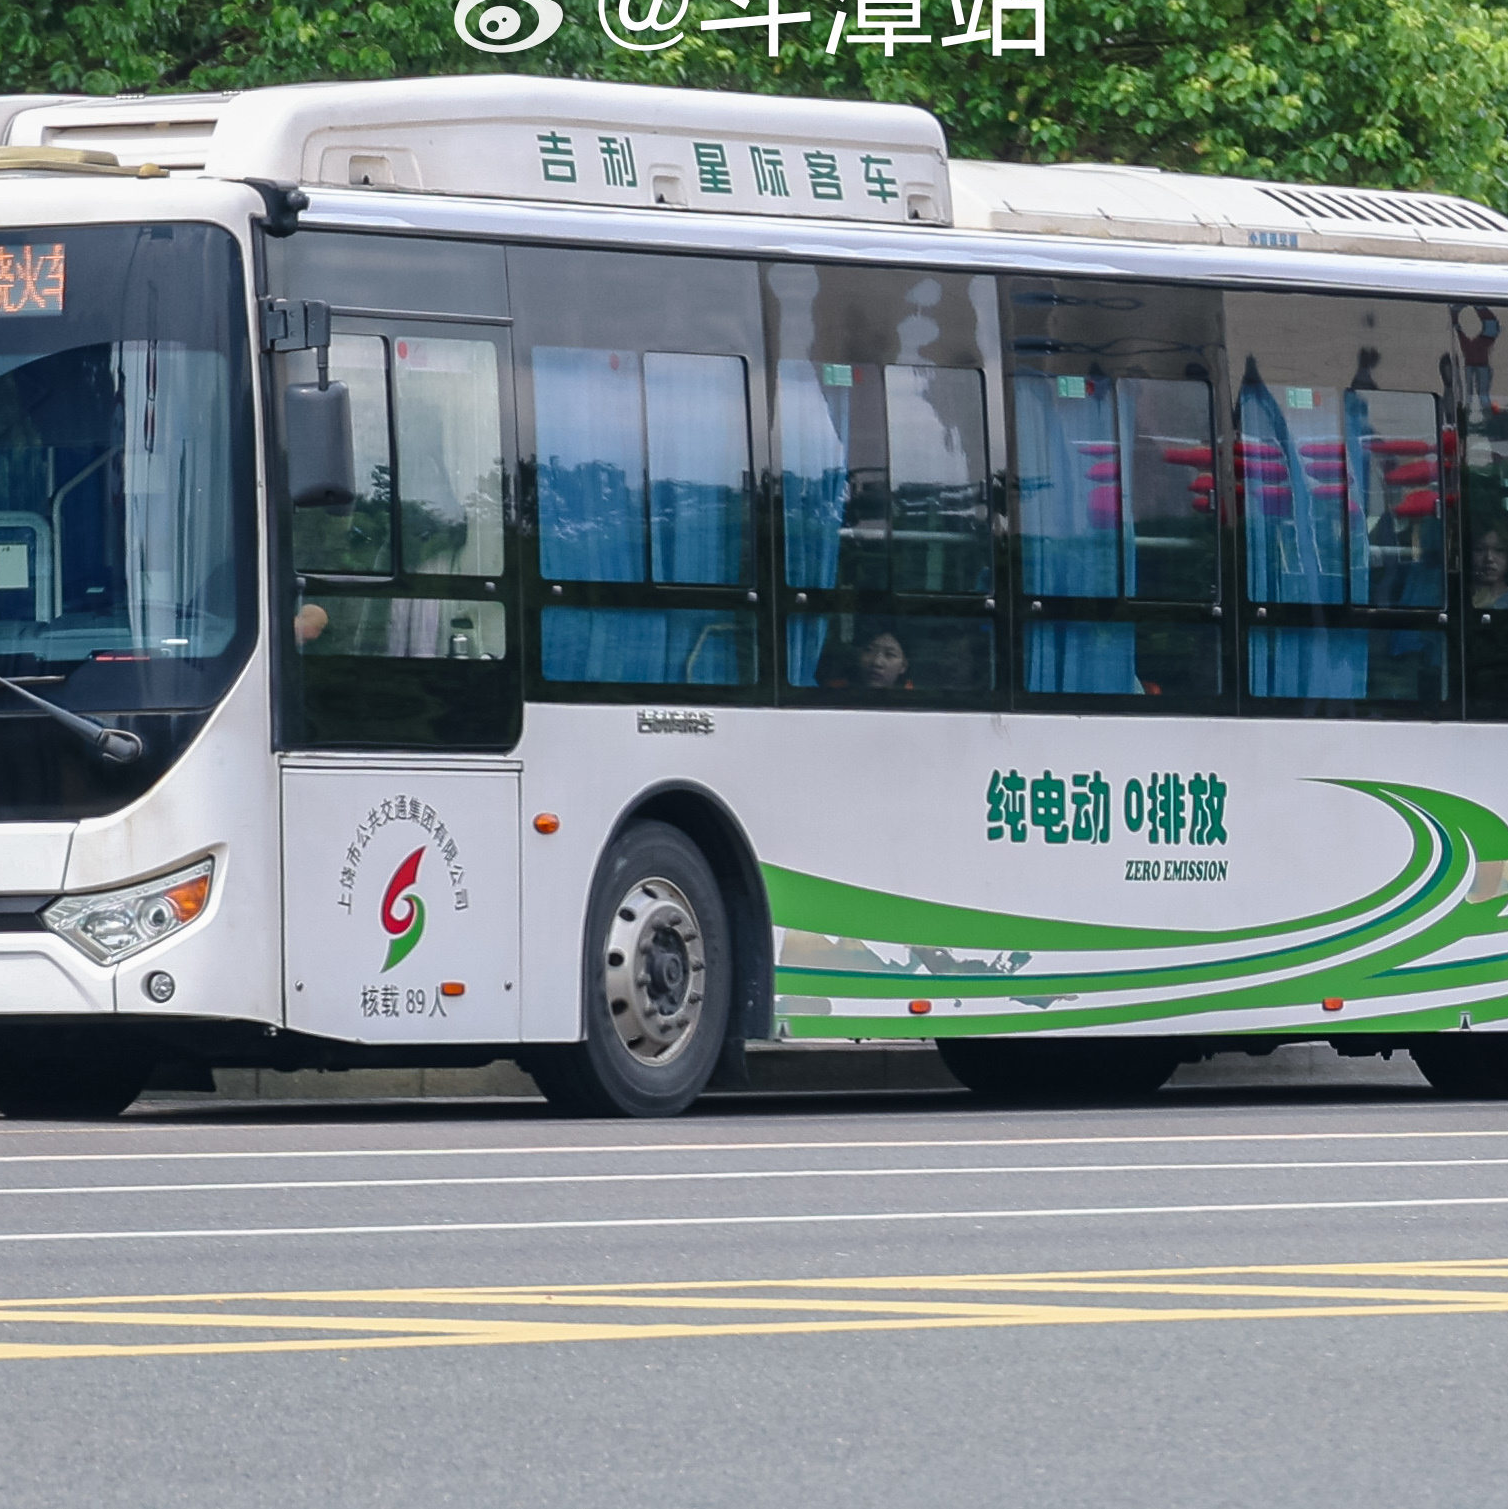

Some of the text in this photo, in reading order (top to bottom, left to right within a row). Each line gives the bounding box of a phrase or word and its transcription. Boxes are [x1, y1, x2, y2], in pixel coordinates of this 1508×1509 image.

[536, 130, 900, 204] 吉利 星际客车
[986, 769, 1228, 846] 纯电动 0排放
[337, 794, 469, 915] 上饶市公共交通集团有限公司
[1124, 860, 1229, 881] ZERO EMISSION
